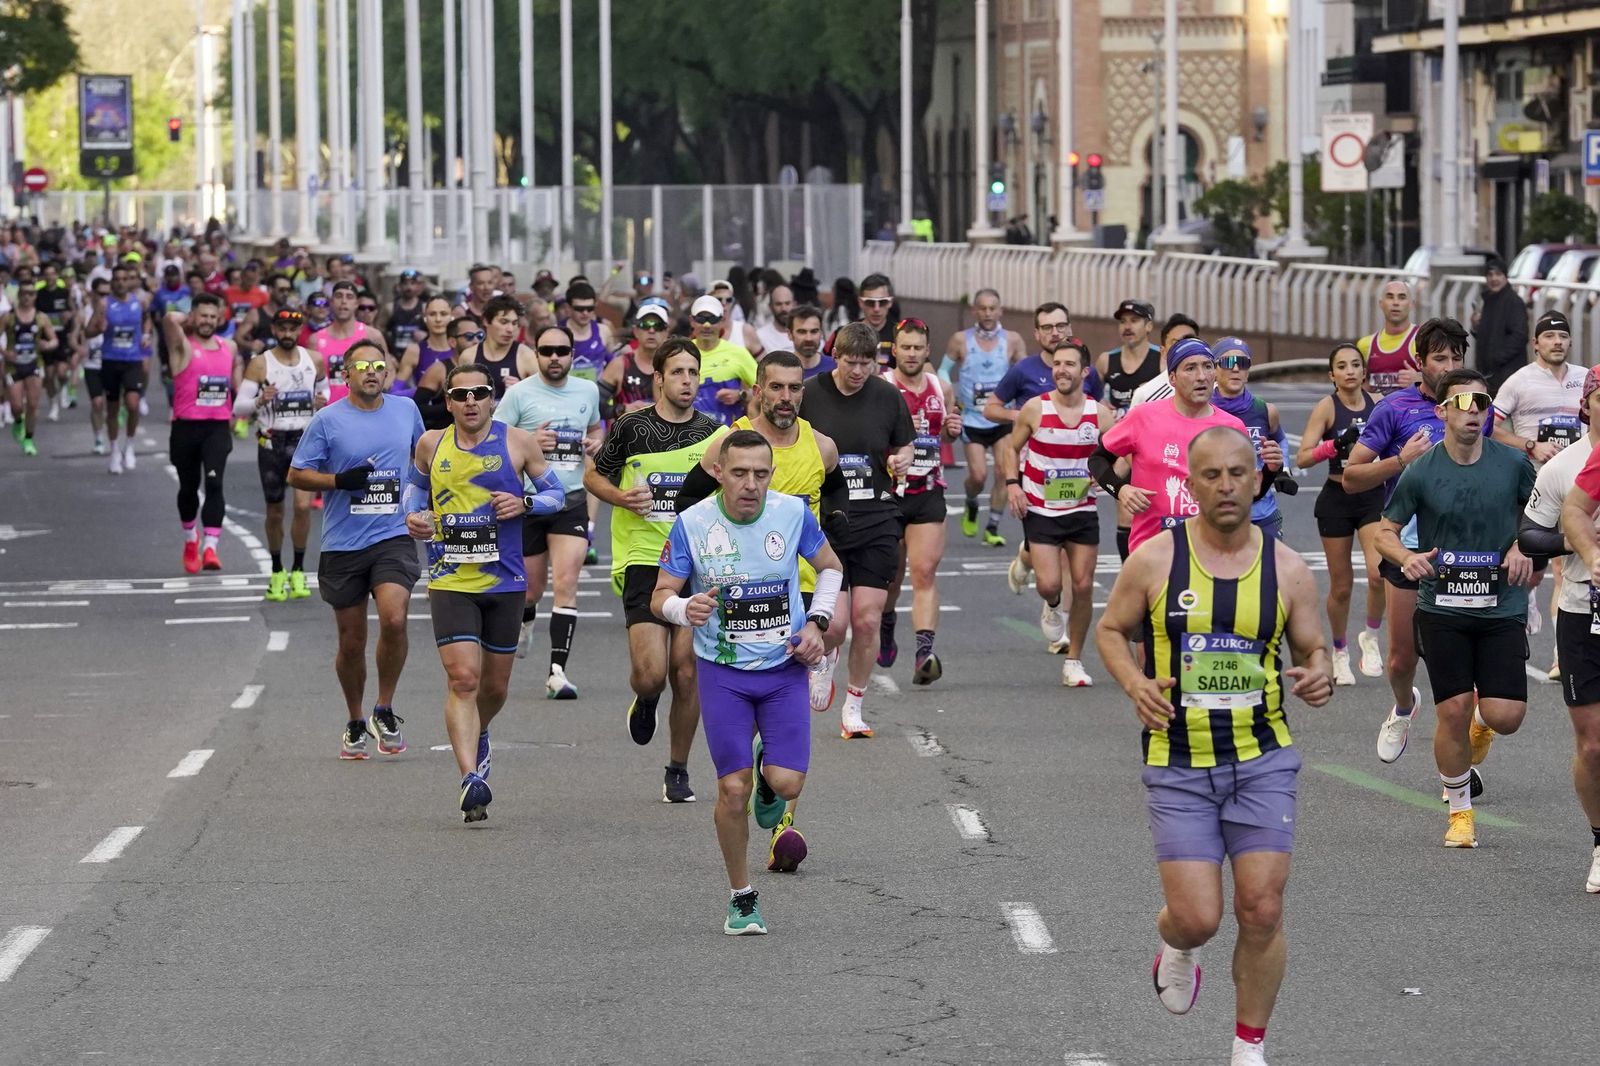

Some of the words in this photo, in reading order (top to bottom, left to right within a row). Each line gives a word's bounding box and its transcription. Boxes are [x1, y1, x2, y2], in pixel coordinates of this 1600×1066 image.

[368, 470, 396, 478] ZURICH
[361, 492, 393, 504] JAKOB
[1059, 490, 1076, 499] FON
[459, 515, 490, 523] ZURICH
[460, 531, 477, 539] 4035
[444, 544, 470, 553] MIGUEL
[472, 543, 498, 553] ANGEL
[1459, 555, 1493, 563] ZURICH
[1459, 571, 1478, 580] 4543
[747, 584, 784, 595] ZURICH
[1447, 580, 1489, 594] RAMÓN
[749, 603, 769, 613] 4378
[725, 619, 757, 630] JESUS
[760, 614, 790, 629] MARIA
[1213, 660, 1238, 671] 2146
[1198, 676, 1251, 691] SABAN
